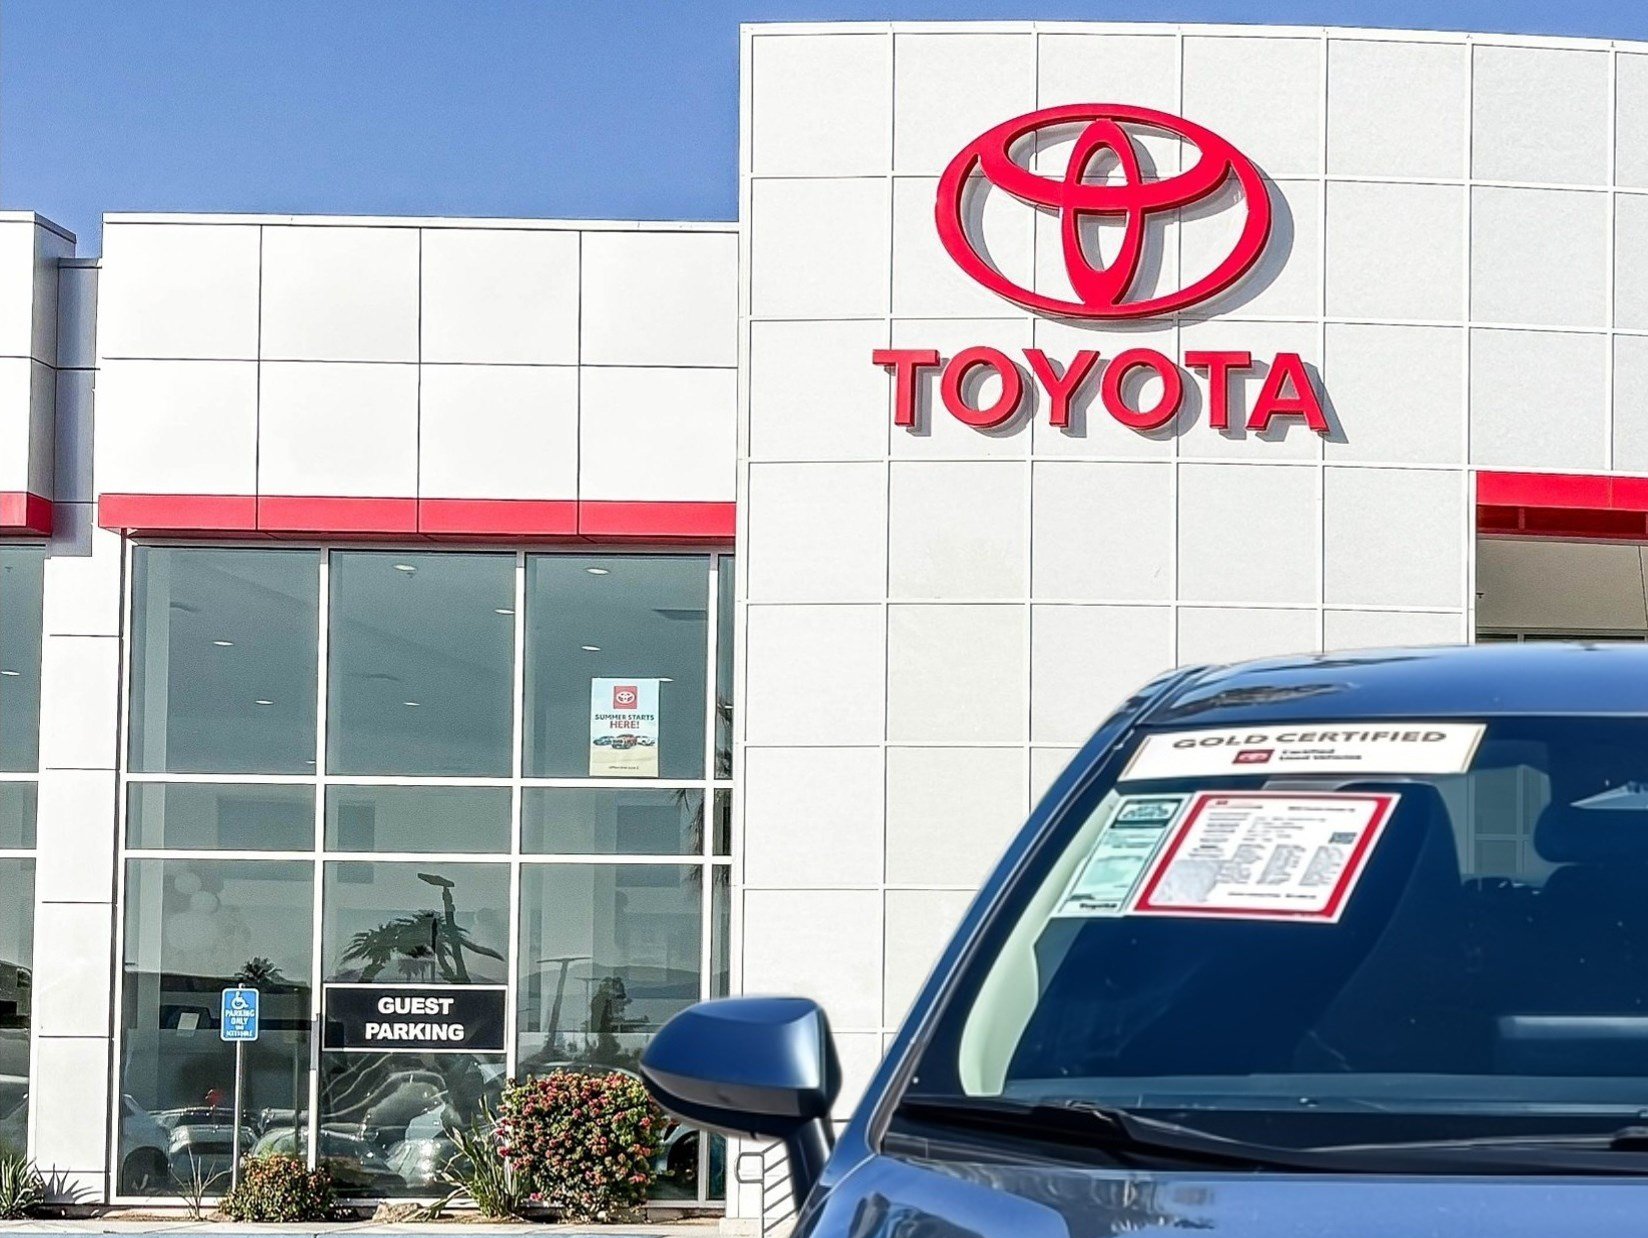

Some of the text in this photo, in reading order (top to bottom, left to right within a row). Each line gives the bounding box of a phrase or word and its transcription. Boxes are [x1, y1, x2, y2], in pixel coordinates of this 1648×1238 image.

[872, 346, 1331, 433] TOYOTA
[609, 721, 640, 729] HERE!
[1173, 731, 1448, 748] GOLD CERTIFIED
[225, 1009, 255, 1017] PARKING
[377, 997, 455, 1015] GUEST
[230, 1017, 249, 1025] ONLY
[365, 1022, 465, 1041] PARKING
